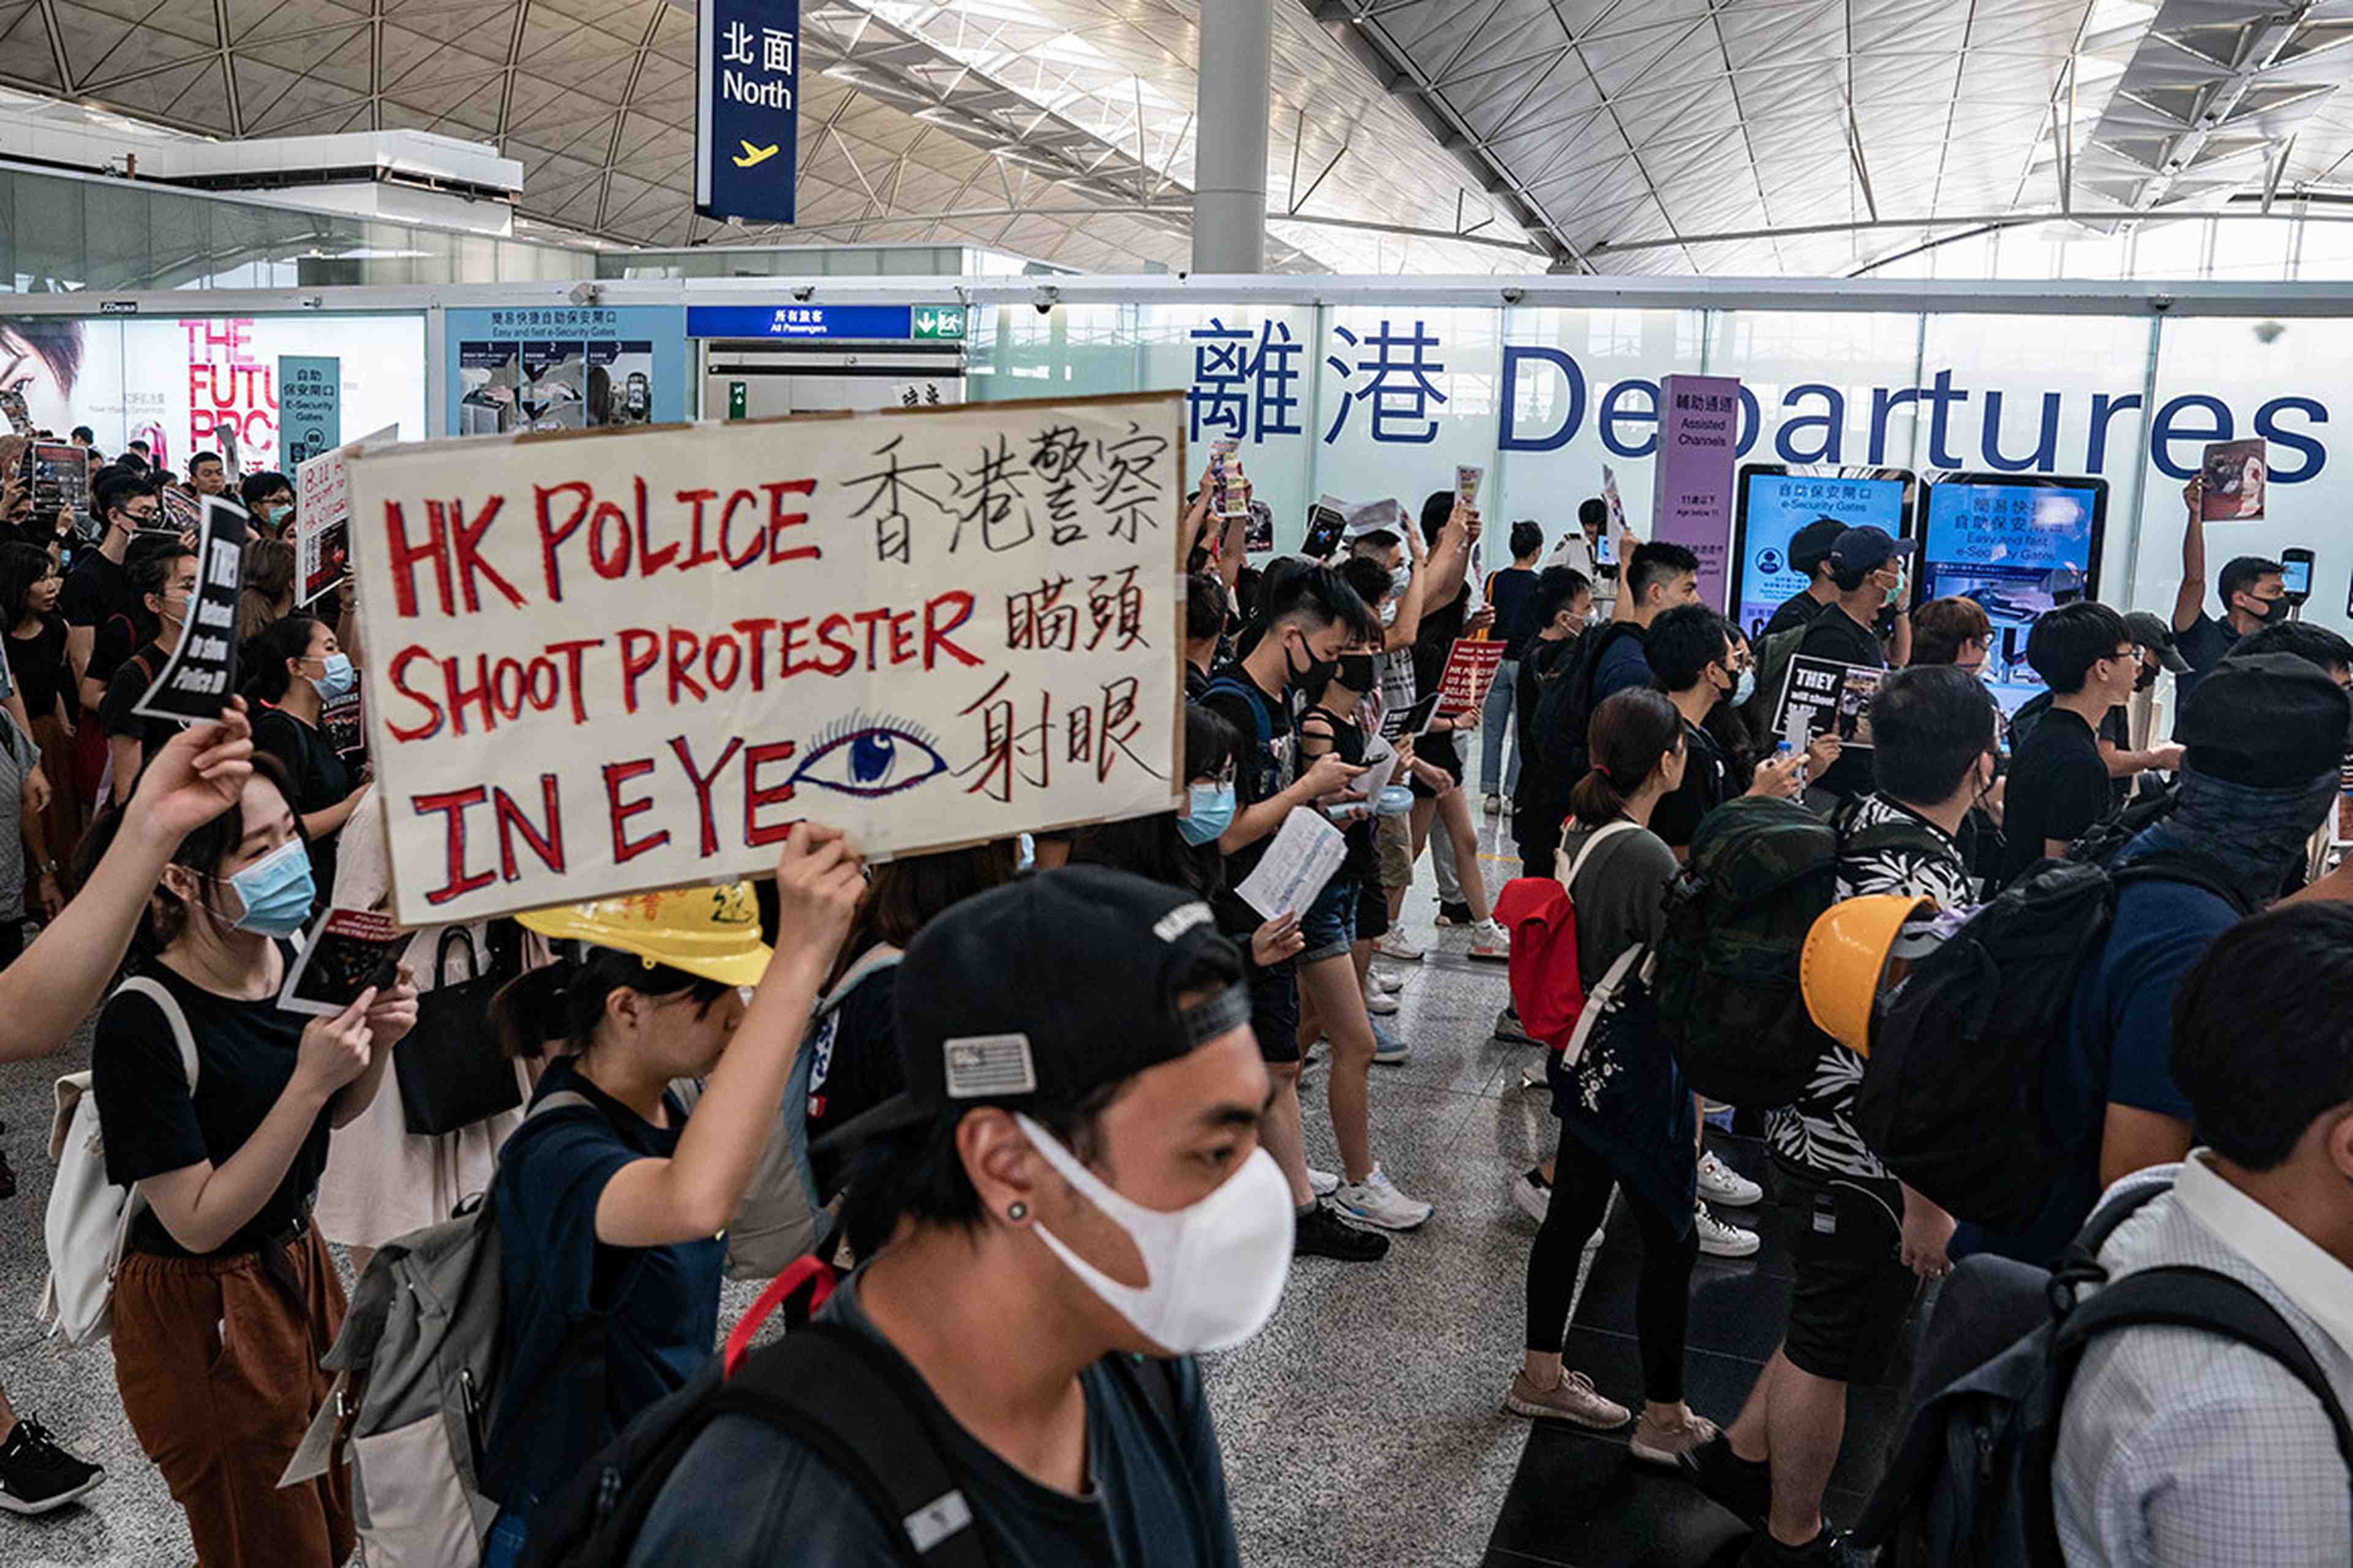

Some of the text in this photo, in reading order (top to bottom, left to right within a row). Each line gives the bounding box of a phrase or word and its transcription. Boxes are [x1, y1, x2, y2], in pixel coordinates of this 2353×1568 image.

[722, 21, 794, 75] 北面
[722, 69, 792, 110] North
[493, 327, 616, 338] Easy and fast e-Security Gates
[770, 323, 827, 334] All Passengers
[179, 317, 254, 363] THE
[488, 342, 623, 352] 1 2 3
[1187, 317, 1447, 445] 離港
[296, 412, 323, 421] Gates
[1681, 418, 1726, 430] Assisted
[1678, 433, 1726, 447] Channels
[841, 422, 1169, 565] 香港警察
[1781, 499, 1867, 512] e-Security Gates
[1974, 498, 2047, 515] 簡易快
[384, 495, 528, 617] HK
[534, 477, 823, 603] POLICE
[1967, 532, 1993, 544] Easy
[1004, 565, 1150, 652] 瞄頭
[385, 590, 985, 743] SHOOT PROTESTER
[1797, 668, 1836, 690] THEY
[1809, 693, 1836, 706] shoot
[950, 672, 1169, 803] 射眼
[410, 735, 807, 905] IN EYE
